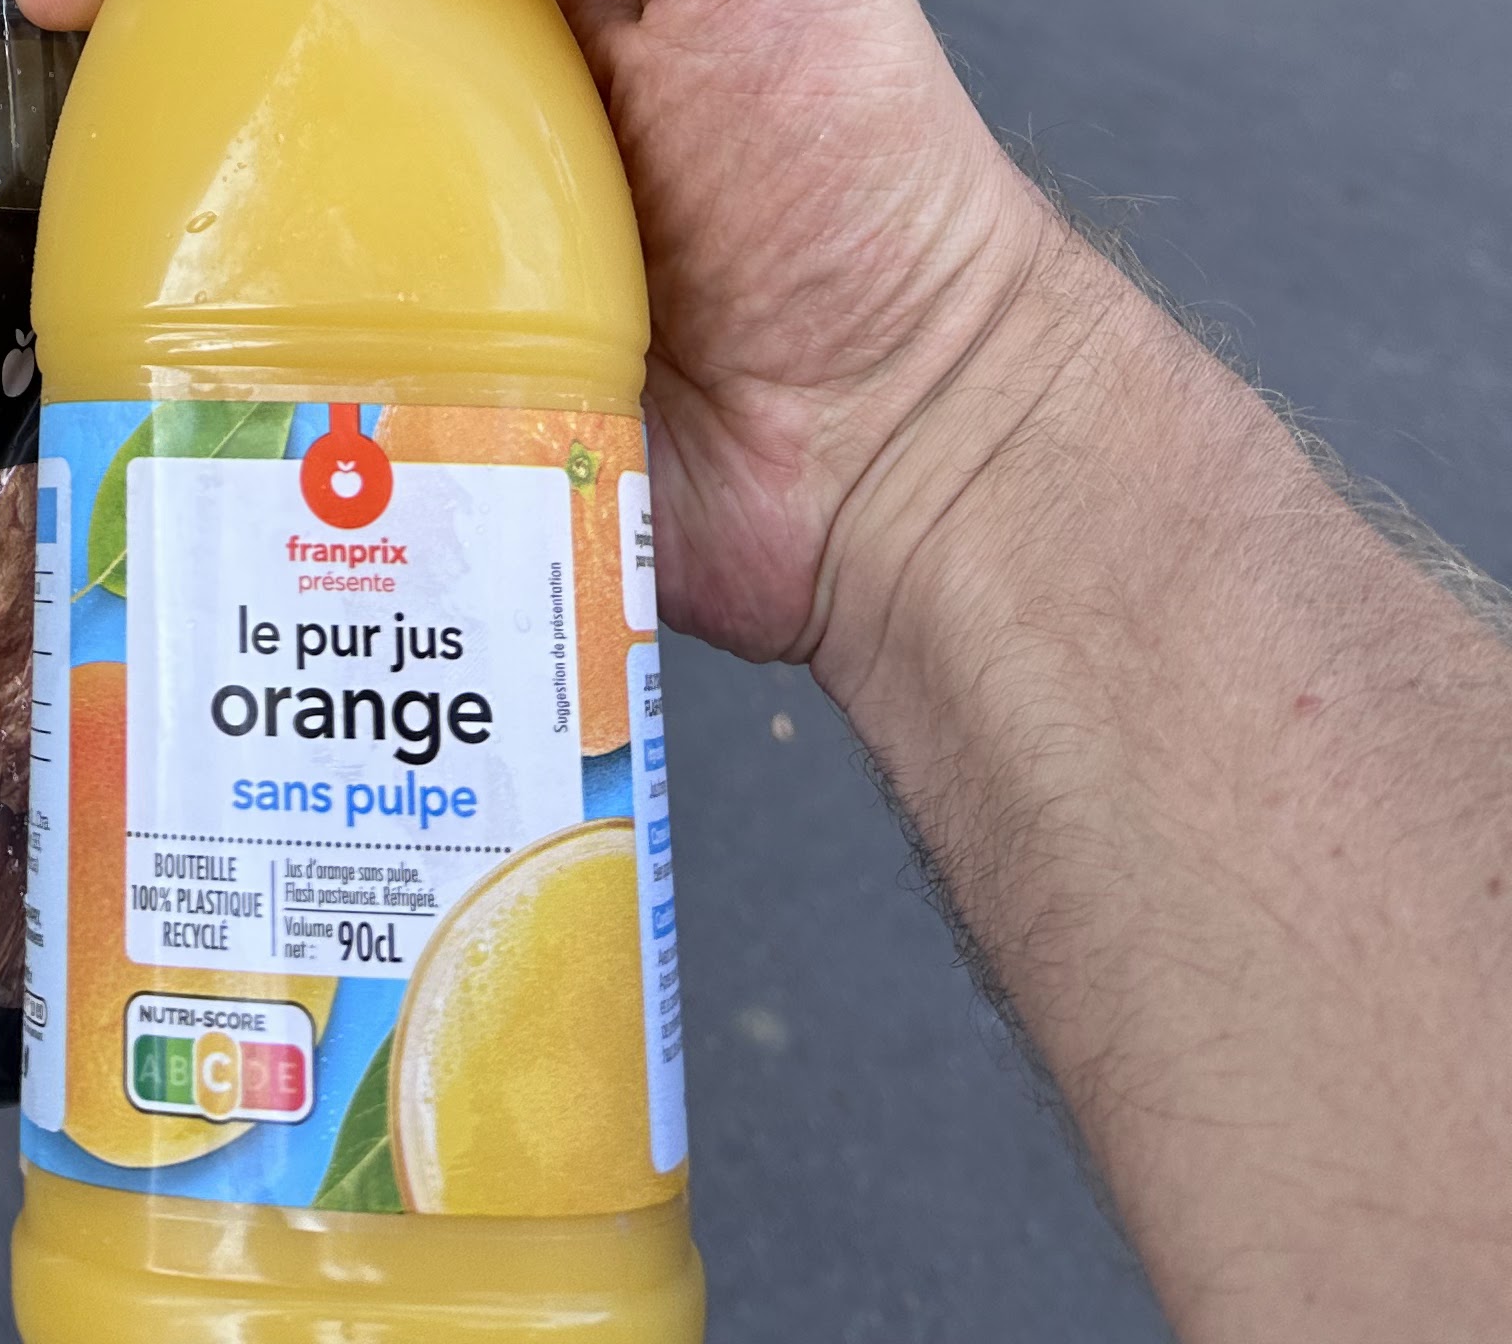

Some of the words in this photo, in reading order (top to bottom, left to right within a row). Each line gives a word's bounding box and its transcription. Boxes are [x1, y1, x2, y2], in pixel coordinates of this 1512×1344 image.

[285, 534, 408, 569] franprix
[299, 571, 396, 594] présente
[548, 561, 568, 641] présentation
[238, 604, 281, 655] le
[295, 623, 381, 670] pur
[390, 612, 464, 673] jus
[550, 642, 566, 660] de
[553, 662, 571, 734] Suggestion
[210, 684, 494, 766] orange
[232, 778, 333, 814] sans
[345, 770, 478, 830] pulpe
[154, 852, 237, 882] BOUTEILLE
[285, 857, 303, 879] Jus
[306, 857, 356, 885] d'orange
[358, 865, 384, 883] sans
[387, 861, 422, 886] pulpe.
[131, 884, 172, 912] 100%
[176, 887, 264, 919] PLASTIQUE
[285, 881, 315, 904] Flash
[317, 886, 380, 908] pasteurisé.
[383, 885, 439, 912] Réfrigéré.
[162, 919, 230, 951] RECYCLÉ
[284, 915, 334, 938] Volume
[284, 941, 306, 959] net
[139, 1004, 266, 1032] NUTRI-SCORE
[140, 1053, 163, 1084] A
[170, 1055, 187, 1086] B
[202, 1052, 233, 1093] C
[278, 1062, 298, 1094] E
